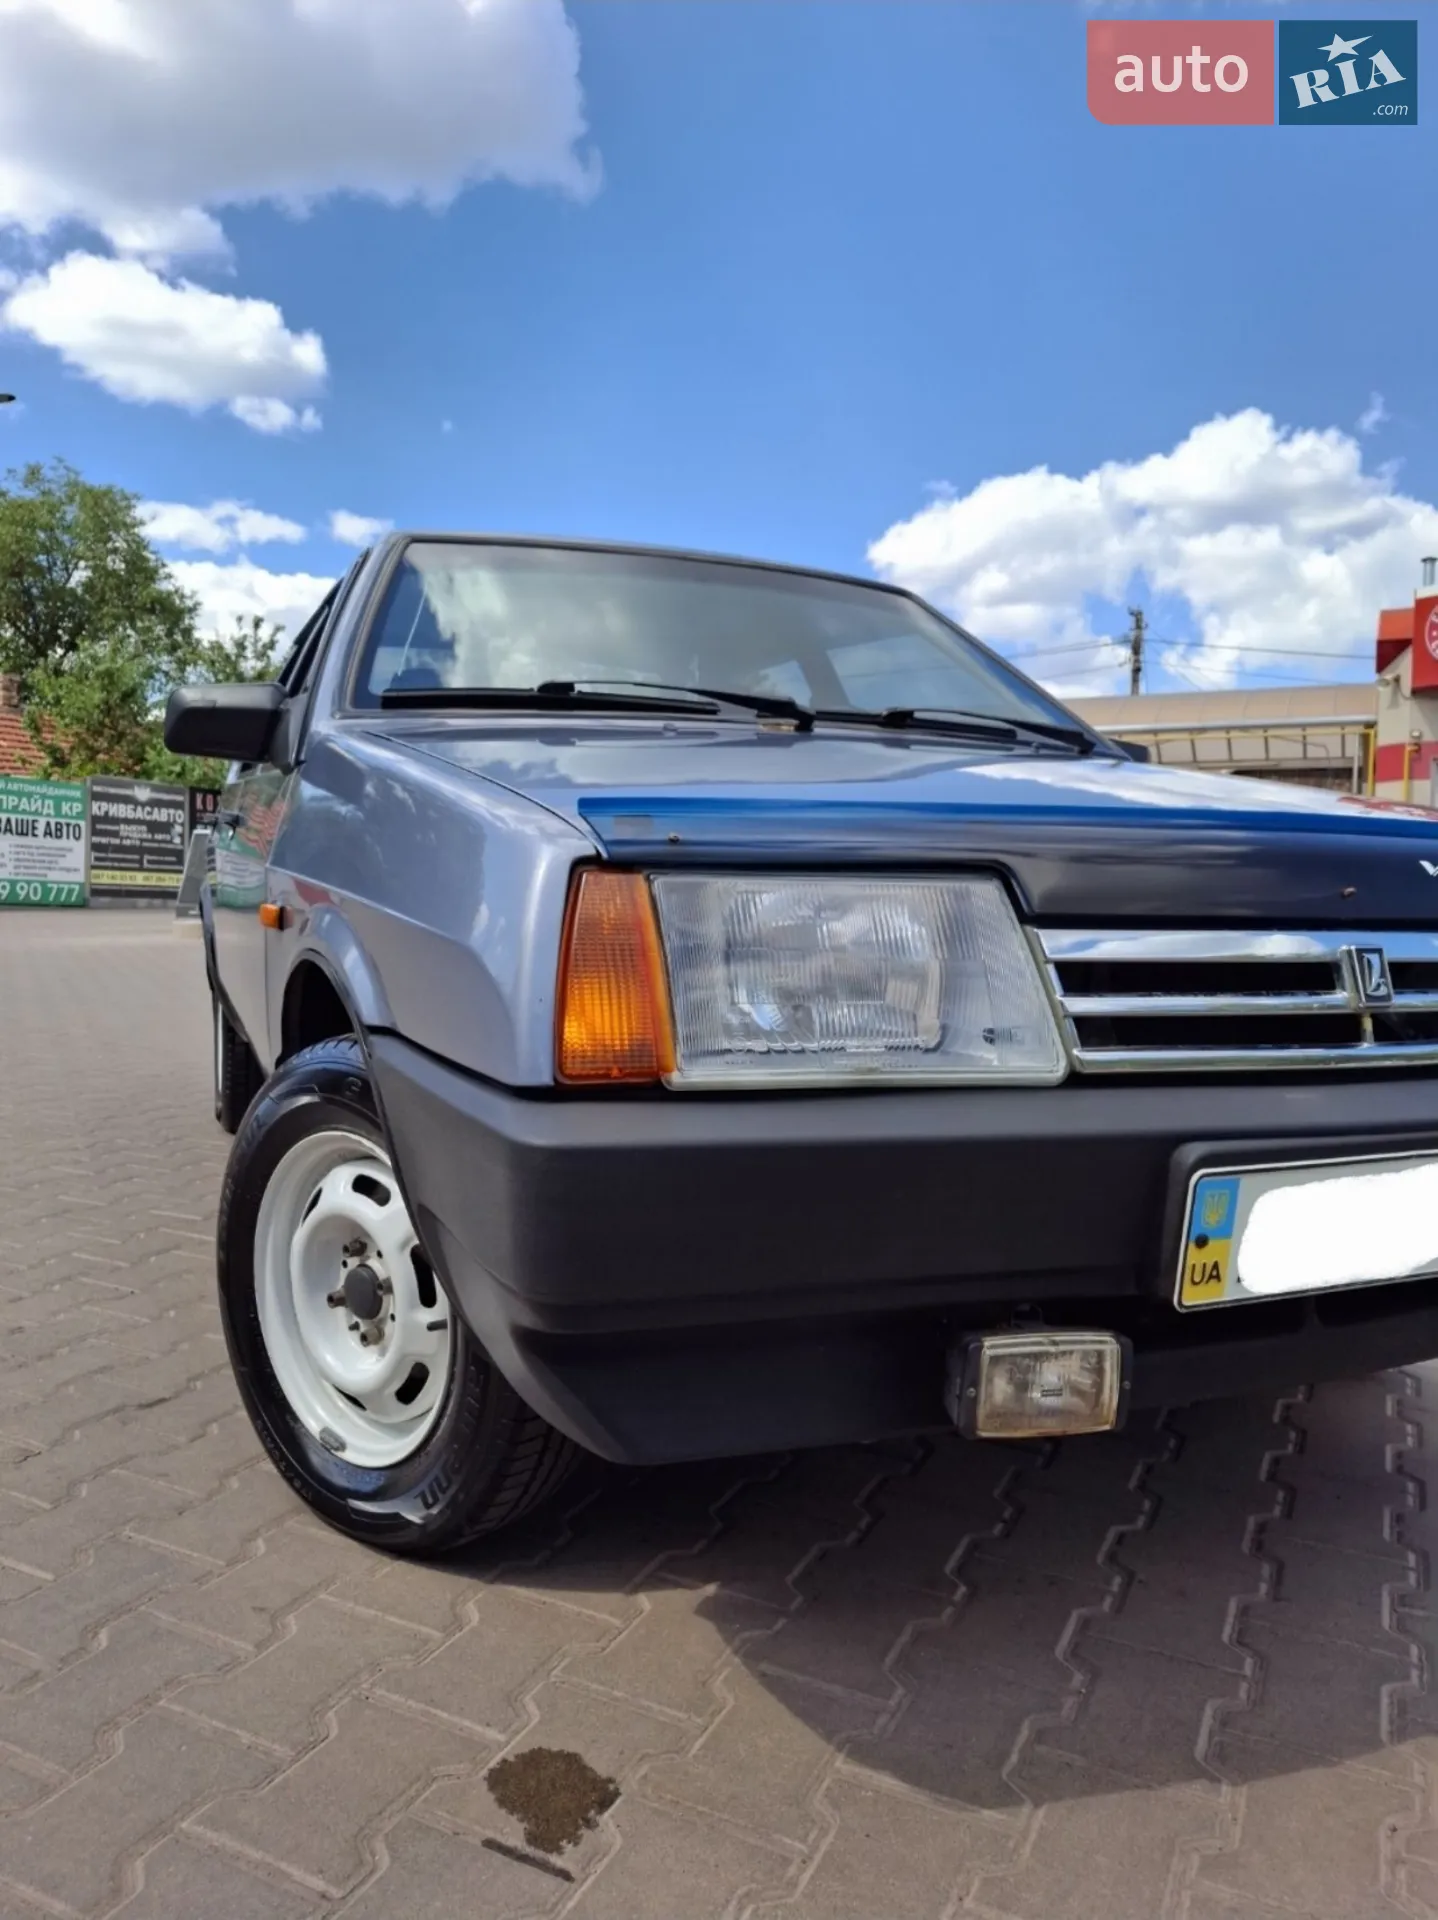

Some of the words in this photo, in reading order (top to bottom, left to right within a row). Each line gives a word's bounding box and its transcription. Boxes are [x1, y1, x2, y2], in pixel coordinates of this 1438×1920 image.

[61, 801, 83, 816] КР
[91, 800, 185, 823] КРИВБАСАВТО
[0, 815, 39, 838] АШЕ
[43, 820, 82, 841] АВТО
[16, 881, 42, 901] 90
[46, 883, 81, 902] 777
[1190, 1260, 1223, 1286] UA
